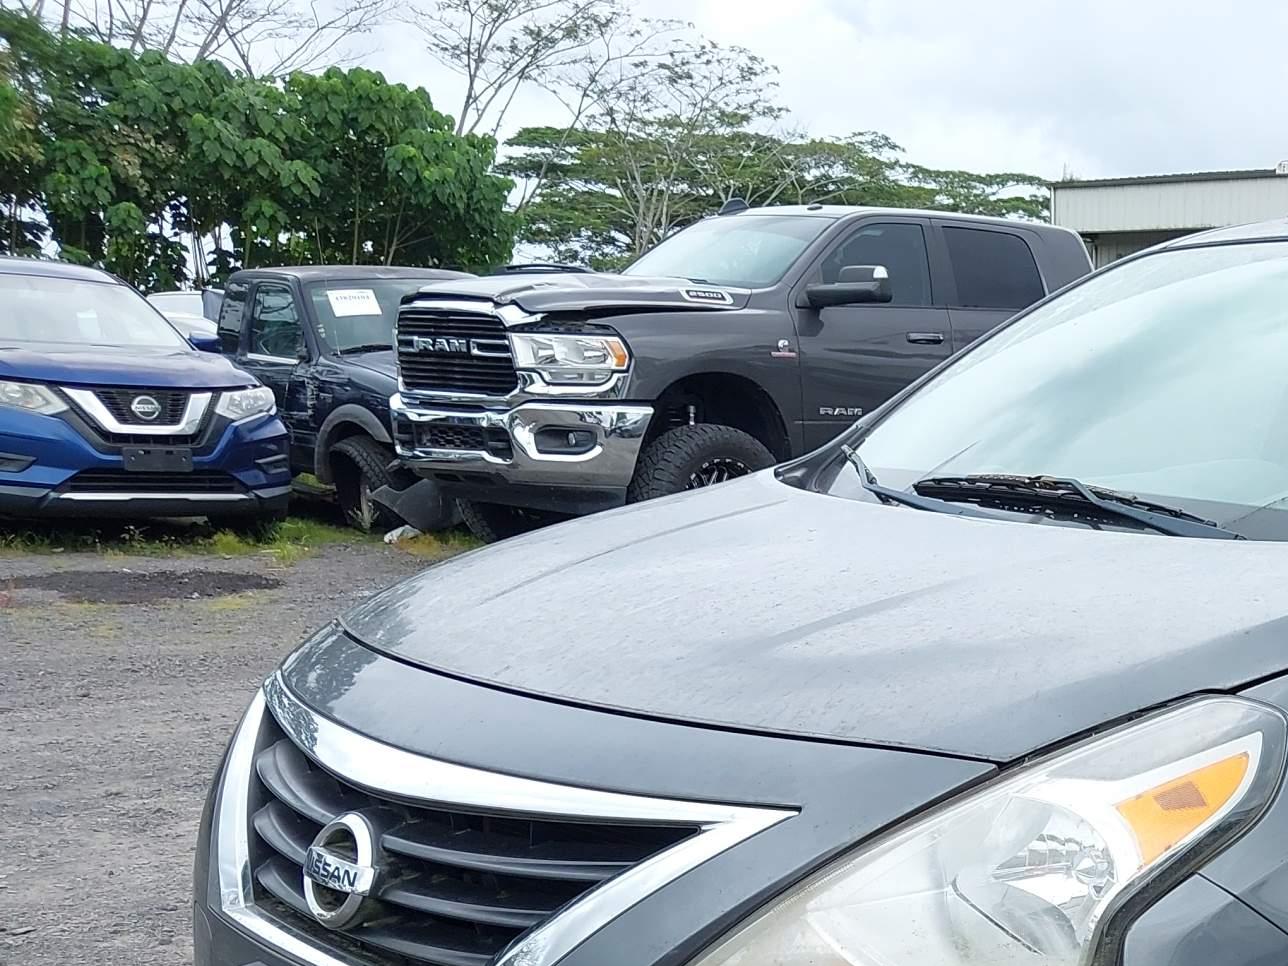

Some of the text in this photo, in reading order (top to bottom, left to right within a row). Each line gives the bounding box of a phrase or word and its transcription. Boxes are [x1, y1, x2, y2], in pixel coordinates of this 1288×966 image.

[688, 290, 722, 299] 2500
[418, 337, 468, 353] RAM
[819, 407, 863, 416] RAM
